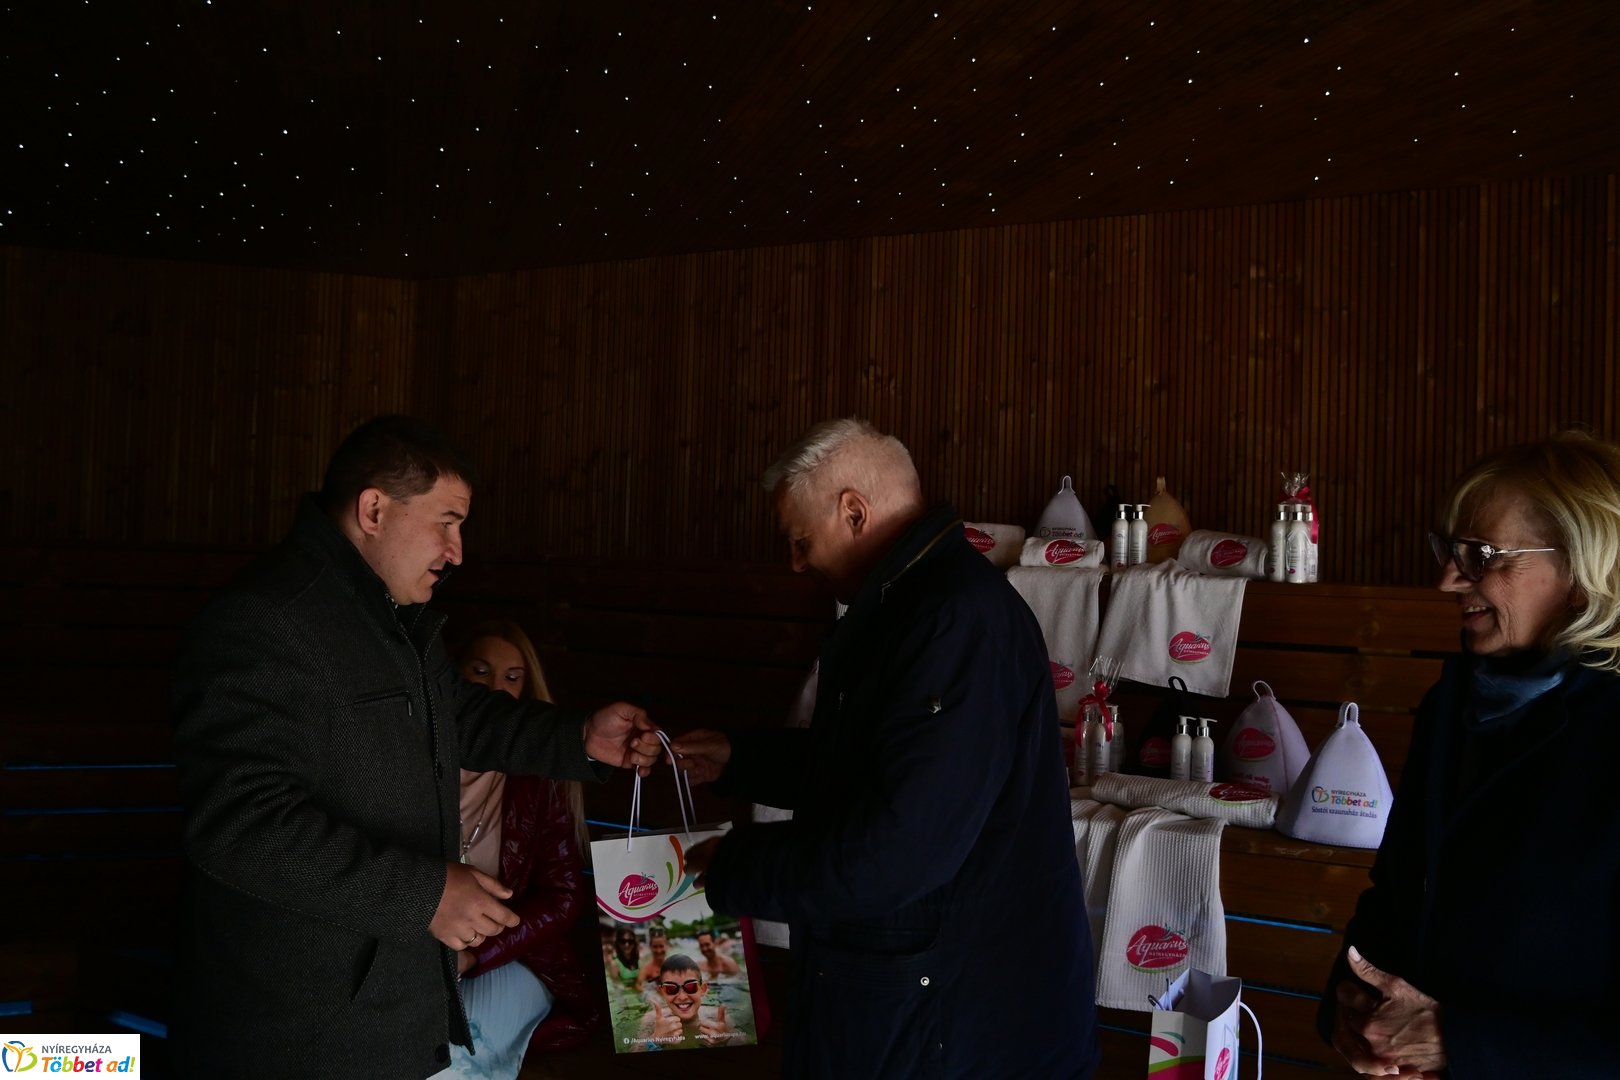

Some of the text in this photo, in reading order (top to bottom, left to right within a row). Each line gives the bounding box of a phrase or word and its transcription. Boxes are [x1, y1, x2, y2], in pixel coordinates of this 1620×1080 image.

[1046, 544, 1085, 563] Aquarius
[1169, 638, 1210, 658] Aquarius
[1331, 789, 1367, 797] NYÍREGYHÁZA
[1331, 796, 1378, 808] Többet ad!
[619, 882, 658, 906] Aquarius
[1127, 934, 1188, 966] Aquarius
